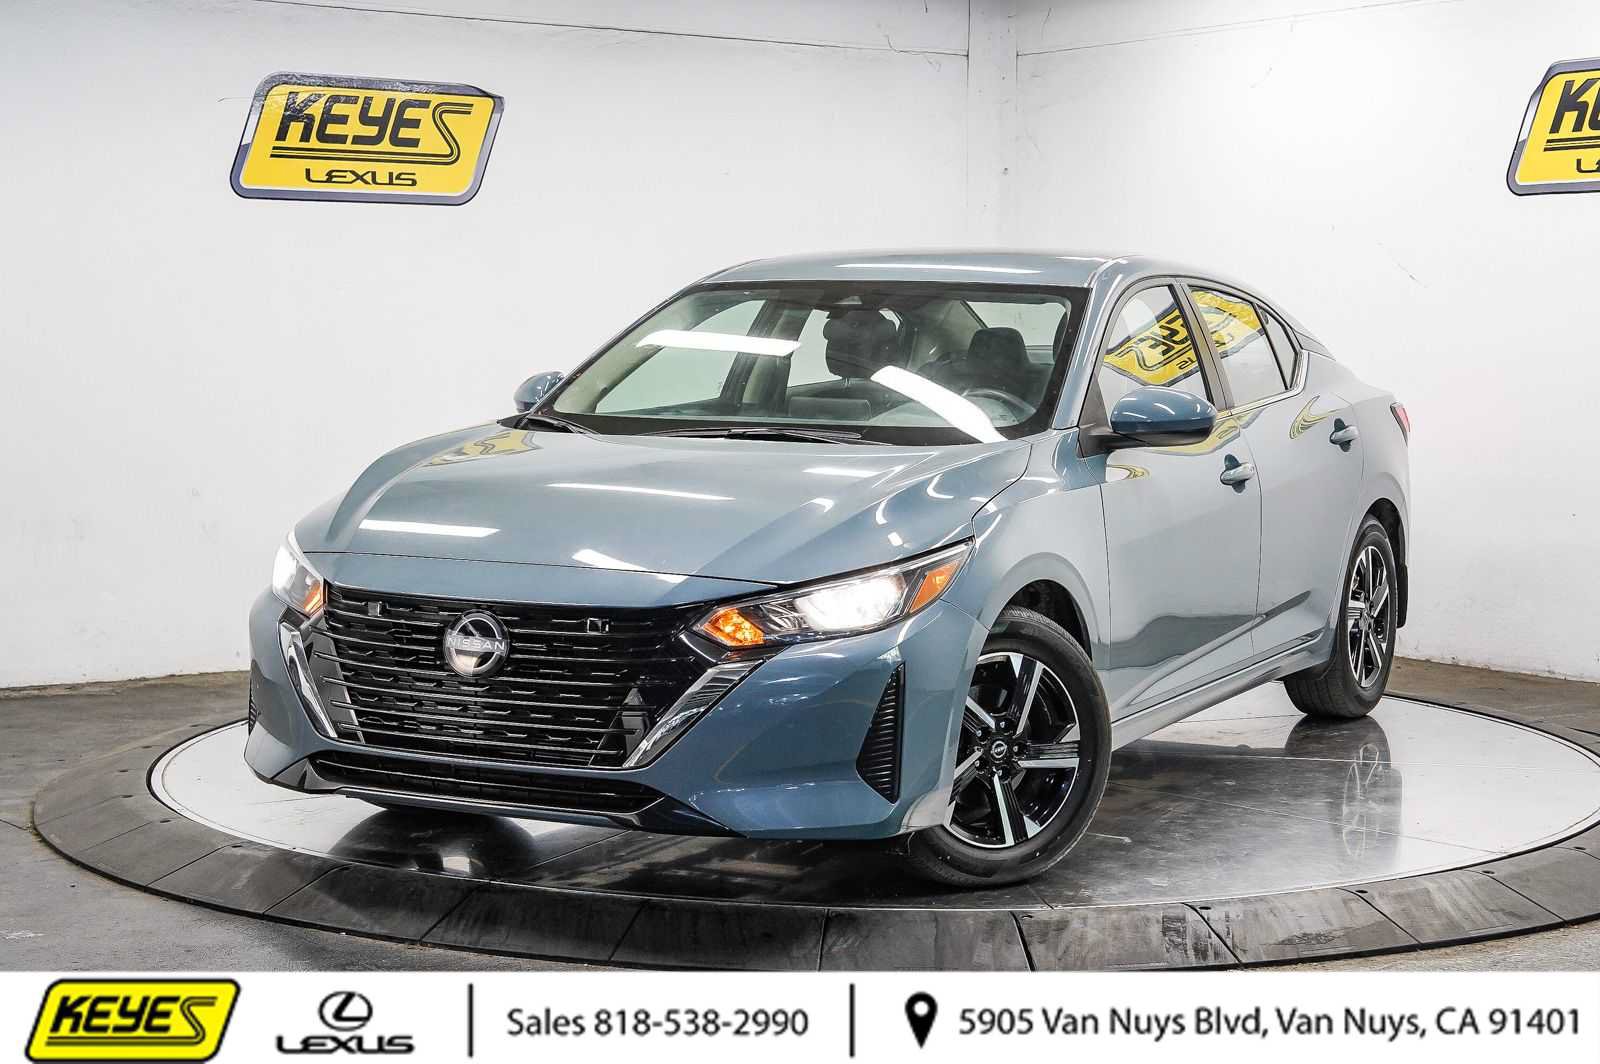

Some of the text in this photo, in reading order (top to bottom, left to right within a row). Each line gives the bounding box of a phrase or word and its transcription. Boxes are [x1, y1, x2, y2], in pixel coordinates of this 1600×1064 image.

[272, 91, 474, 165] KEYES
[305, 168, 417, 187] LEXUS
[447, 637, 505, 651] NISSAN
